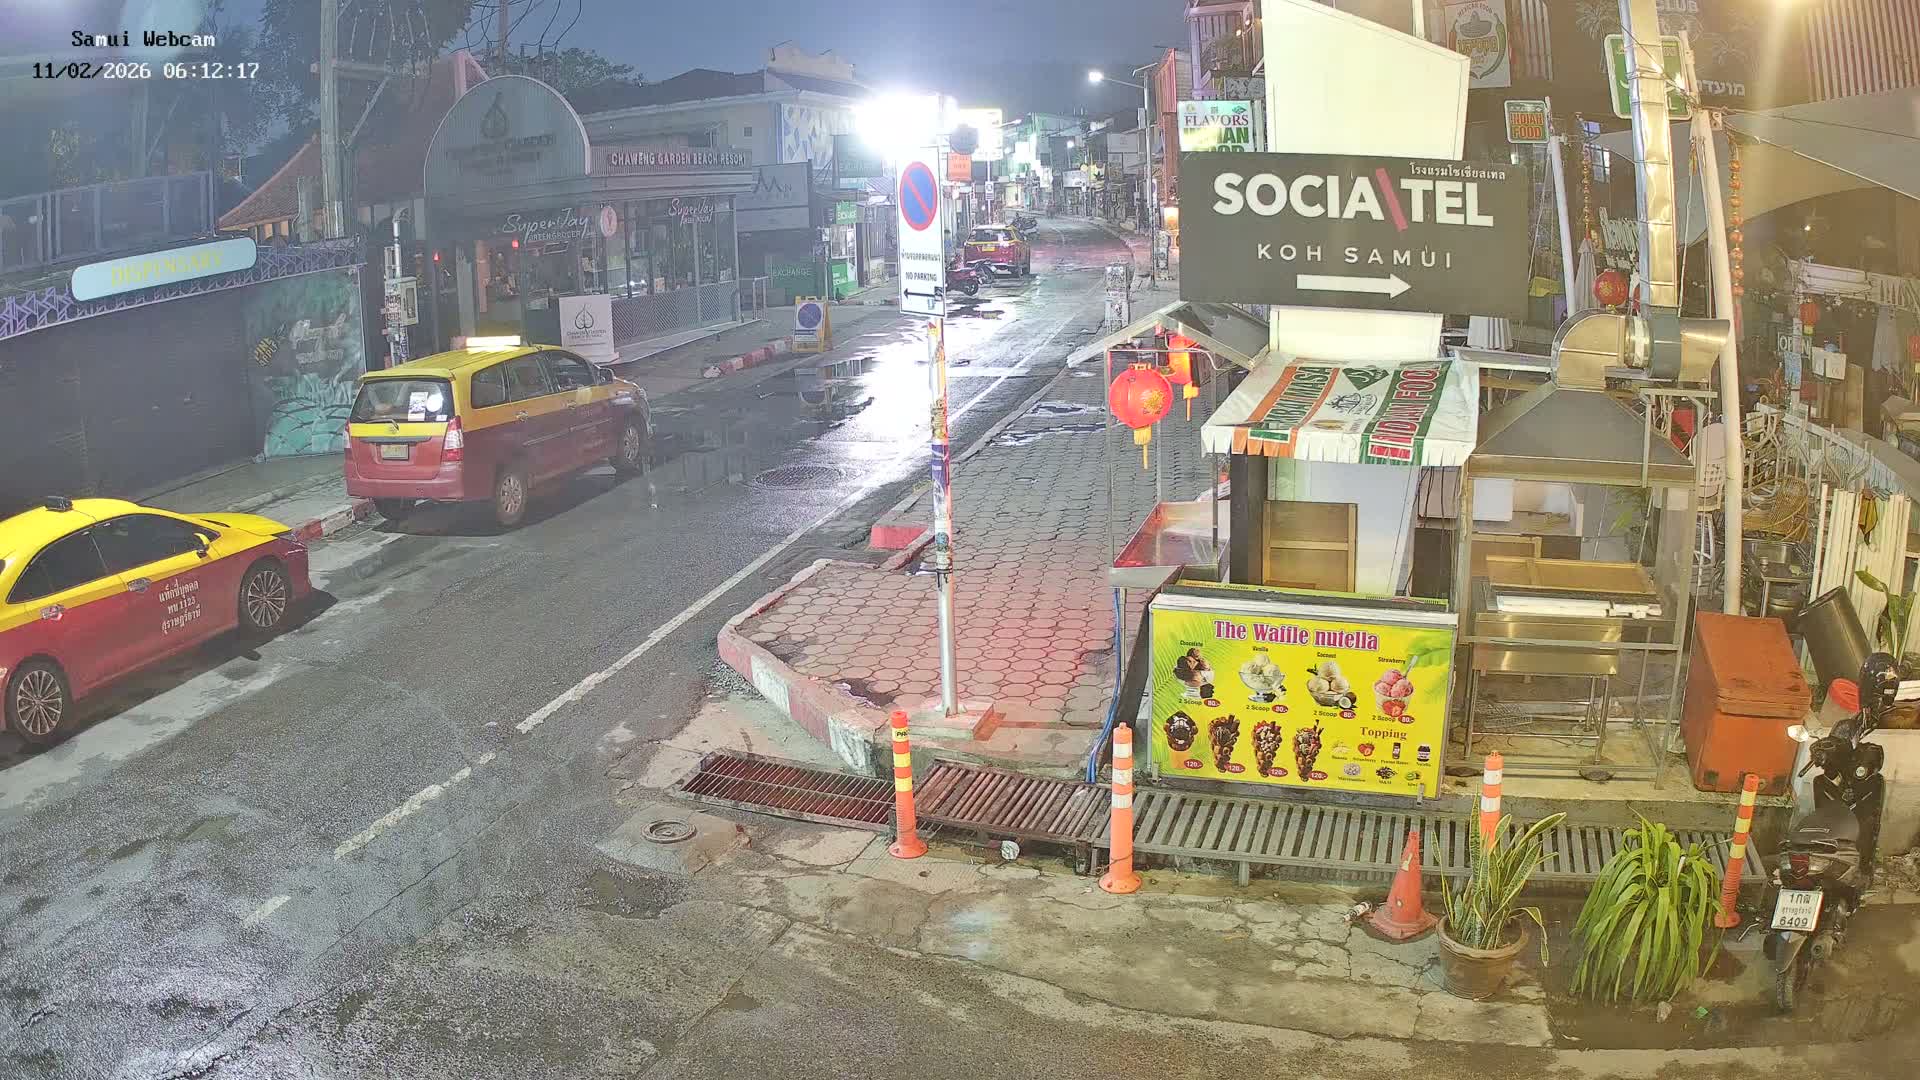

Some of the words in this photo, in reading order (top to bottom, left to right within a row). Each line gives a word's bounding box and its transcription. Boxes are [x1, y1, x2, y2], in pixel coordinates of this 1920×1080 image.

[1184, 114, 1249, 127] FLAVORS
[1511, 112, 1543, 125] INDIAN
[1512, 126, 1542, 139] FOOD
[611, 152, 655, 166] CHAWENG
[657, 152, 691, 165] GARDEN
[693, 152, 718, 165] BEACH
[720, 152, 746, 165] RESORT
[1257, 243, 1322, 262] KOH
[1344, 245, 1451, 269] SAMUI
[111, 251, 225, 288] DISPENSARY
[905, 272, 913, 280] NO
[914, 272, 937, 281] PARKING
[1213, 620, 1247, 640] The
[1253, 623, 1308, 645] Waffle
[1314, 629, 1379, 650] nutella
[1378, 656, 1406, 664] Strawberry
[1360, 726, 1407, 740] Topping
[1780, 916, 1808, 927] 6409
